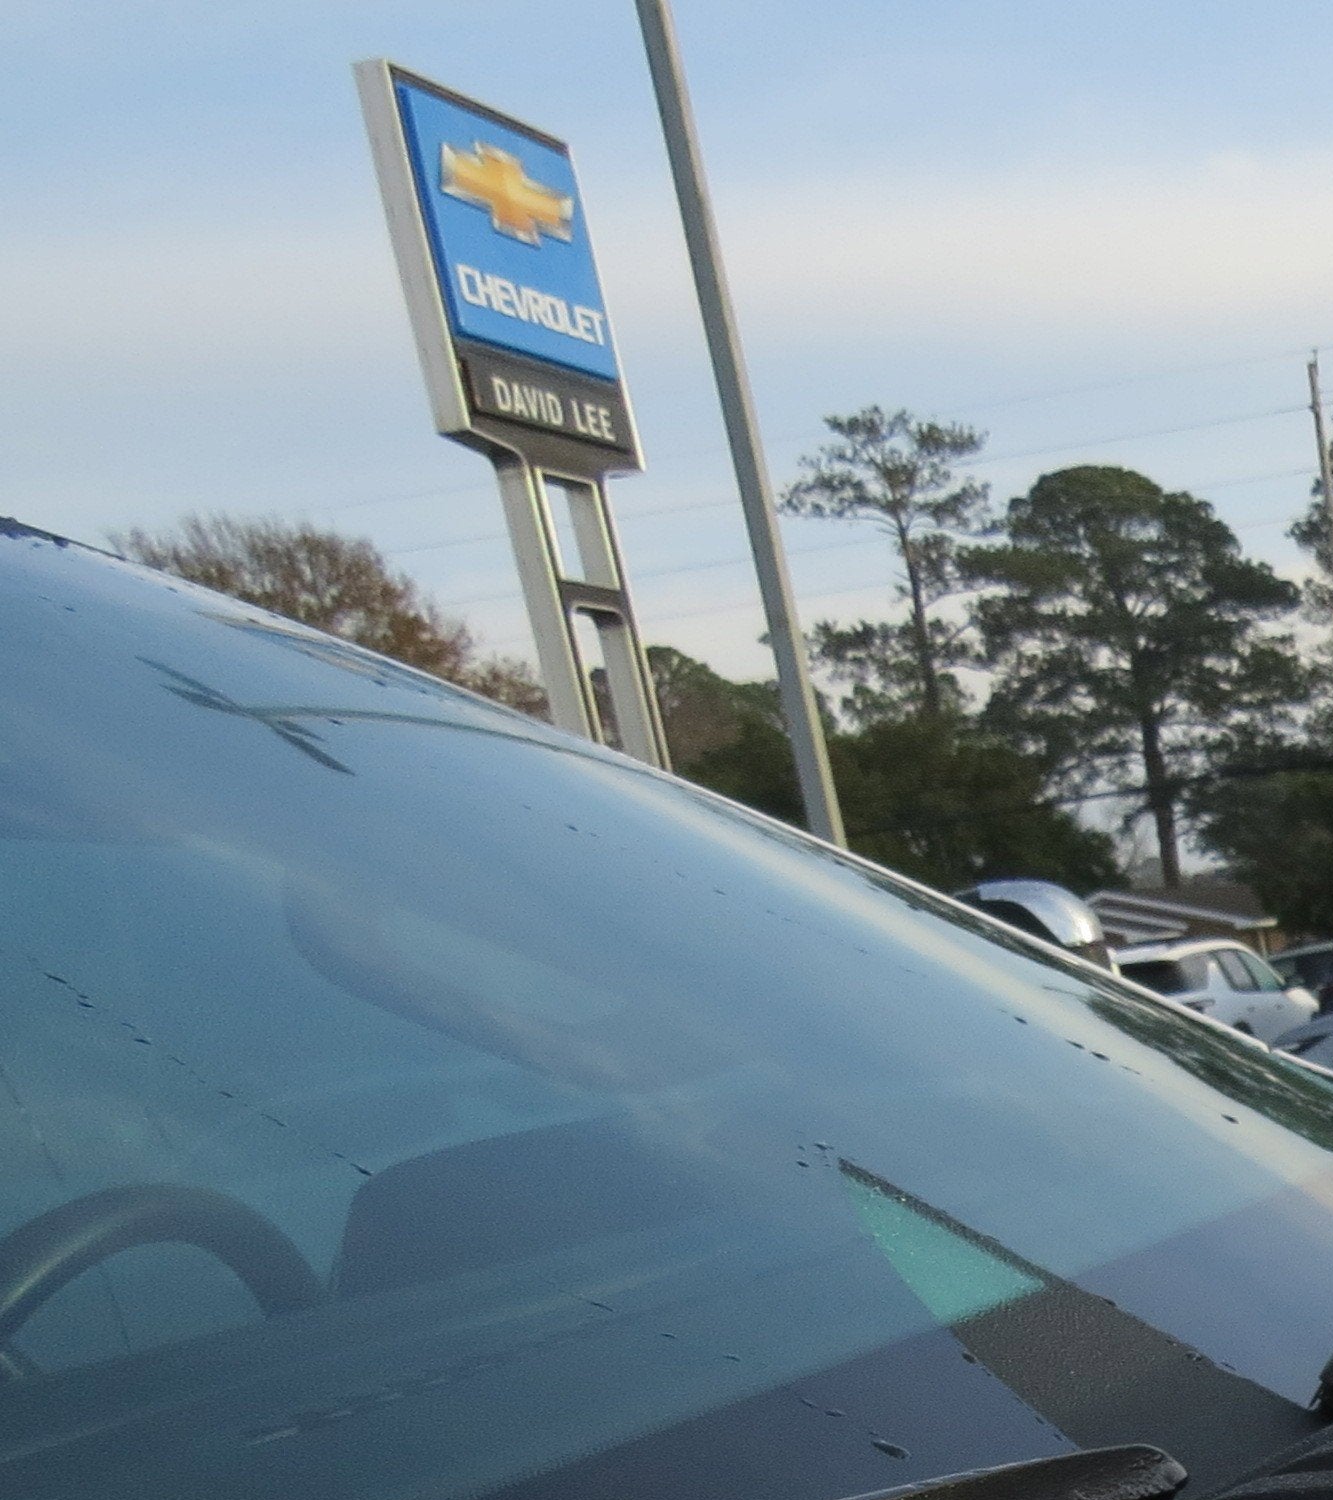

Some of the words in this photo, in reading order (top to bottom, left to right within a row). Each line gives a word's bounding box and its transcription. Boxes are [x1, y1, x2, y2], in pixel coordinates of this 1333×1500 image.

[457, 264, 603, 345] CHEVROLET
[492, 378, 563, 426] DAVID
[572, 400, 615, 440] LEE
